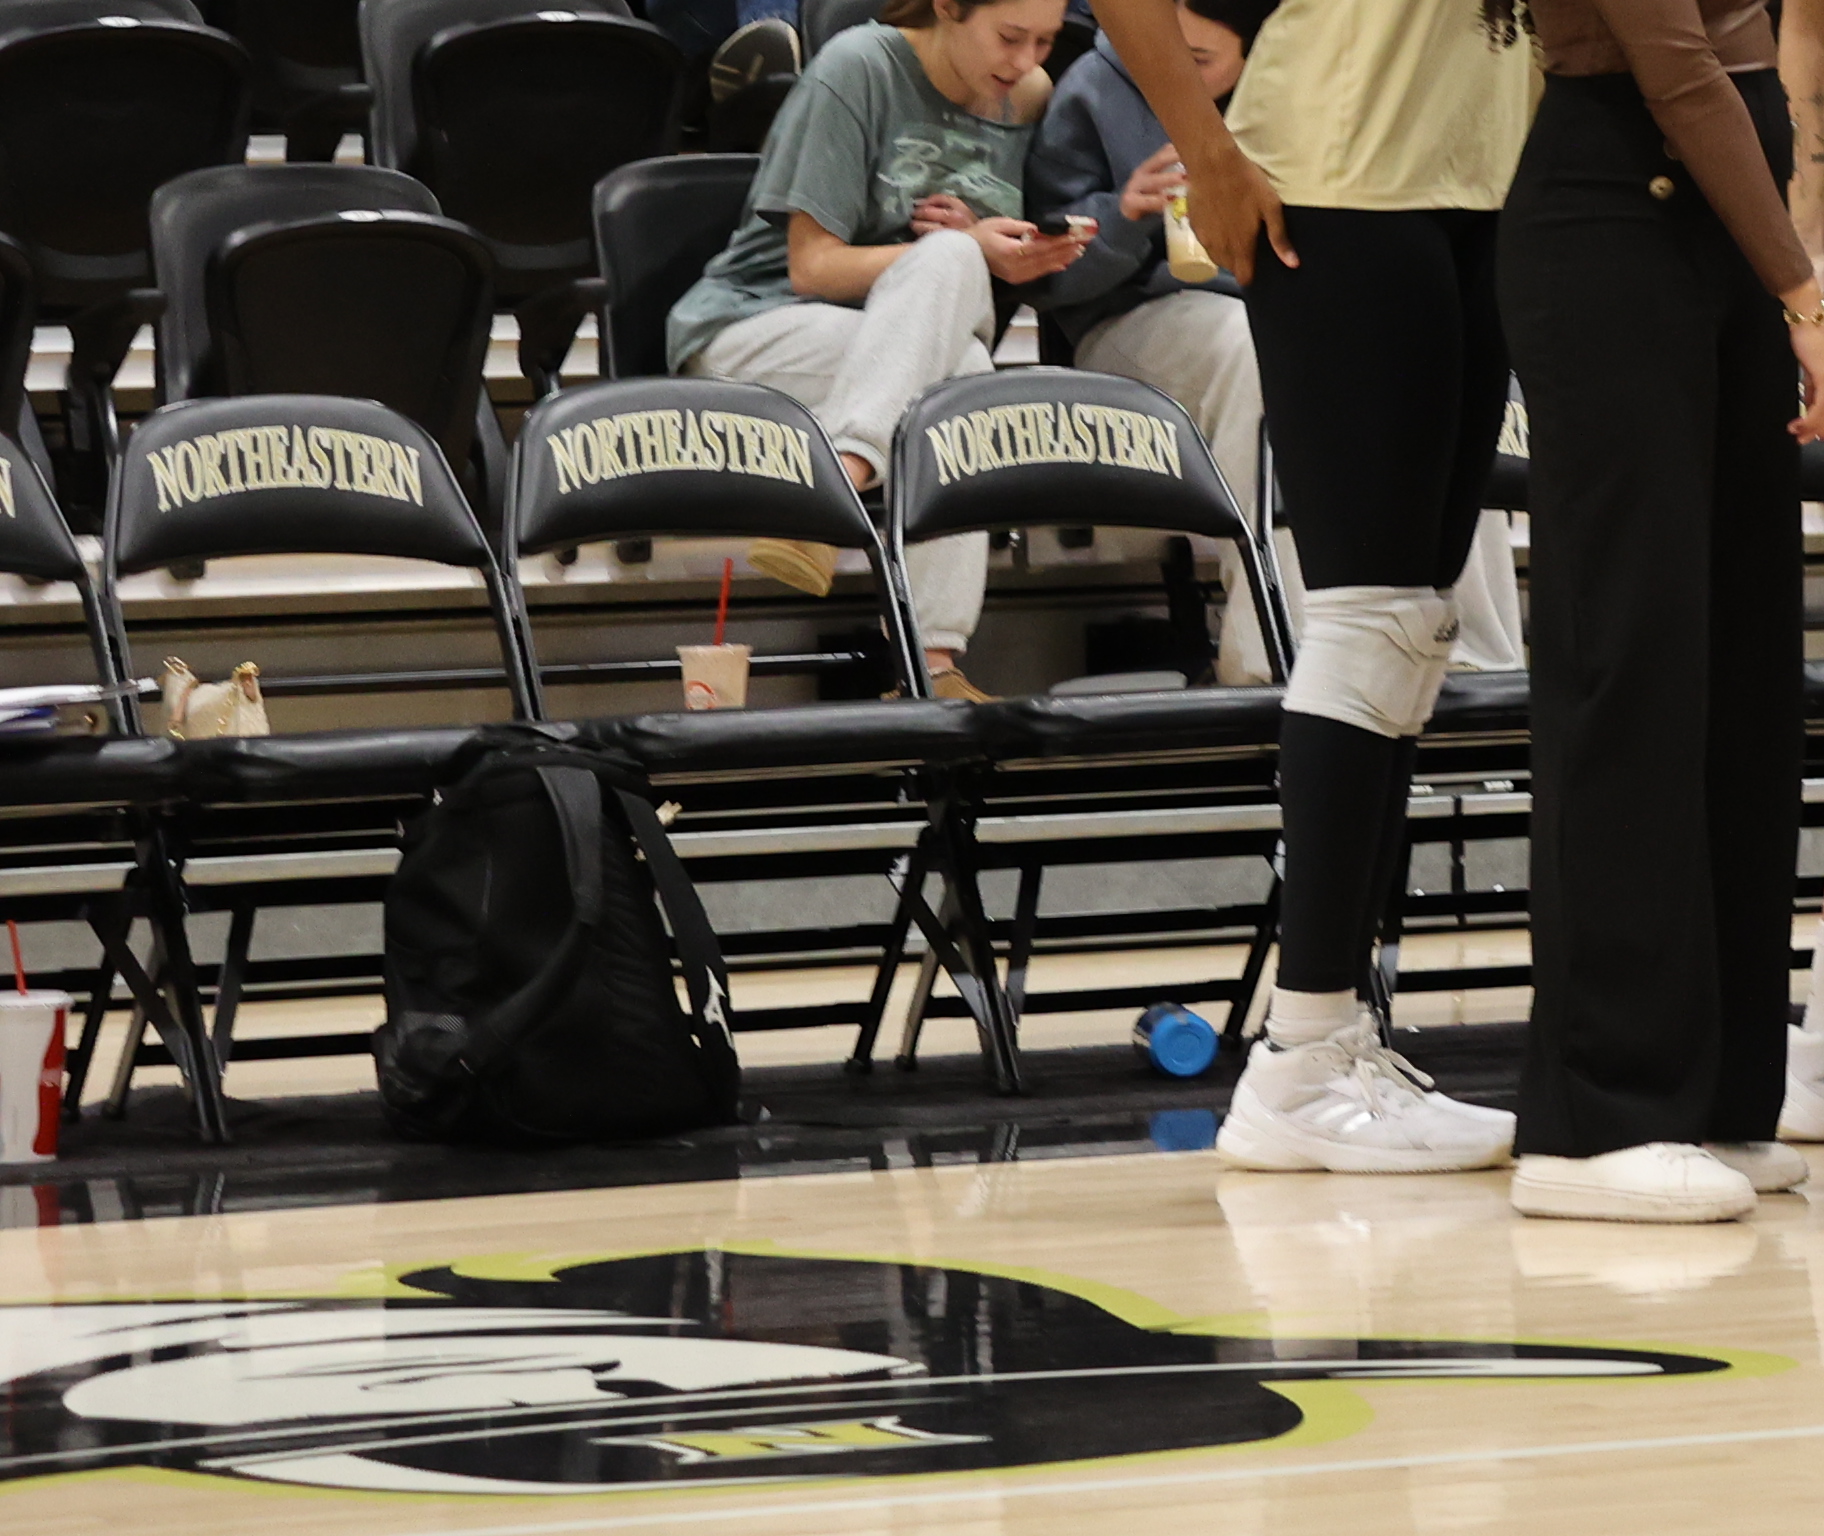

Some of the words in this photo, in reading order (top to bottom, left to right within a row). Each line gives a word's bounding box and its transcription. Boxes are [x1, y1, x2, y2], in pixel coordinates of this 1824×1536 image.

[146, 424, 424, 513] NORTHEASTERN
[547, 408, 816, 495] NORTHEASTERN
[925, 401, 1184, 486] NORTHEASTERN
